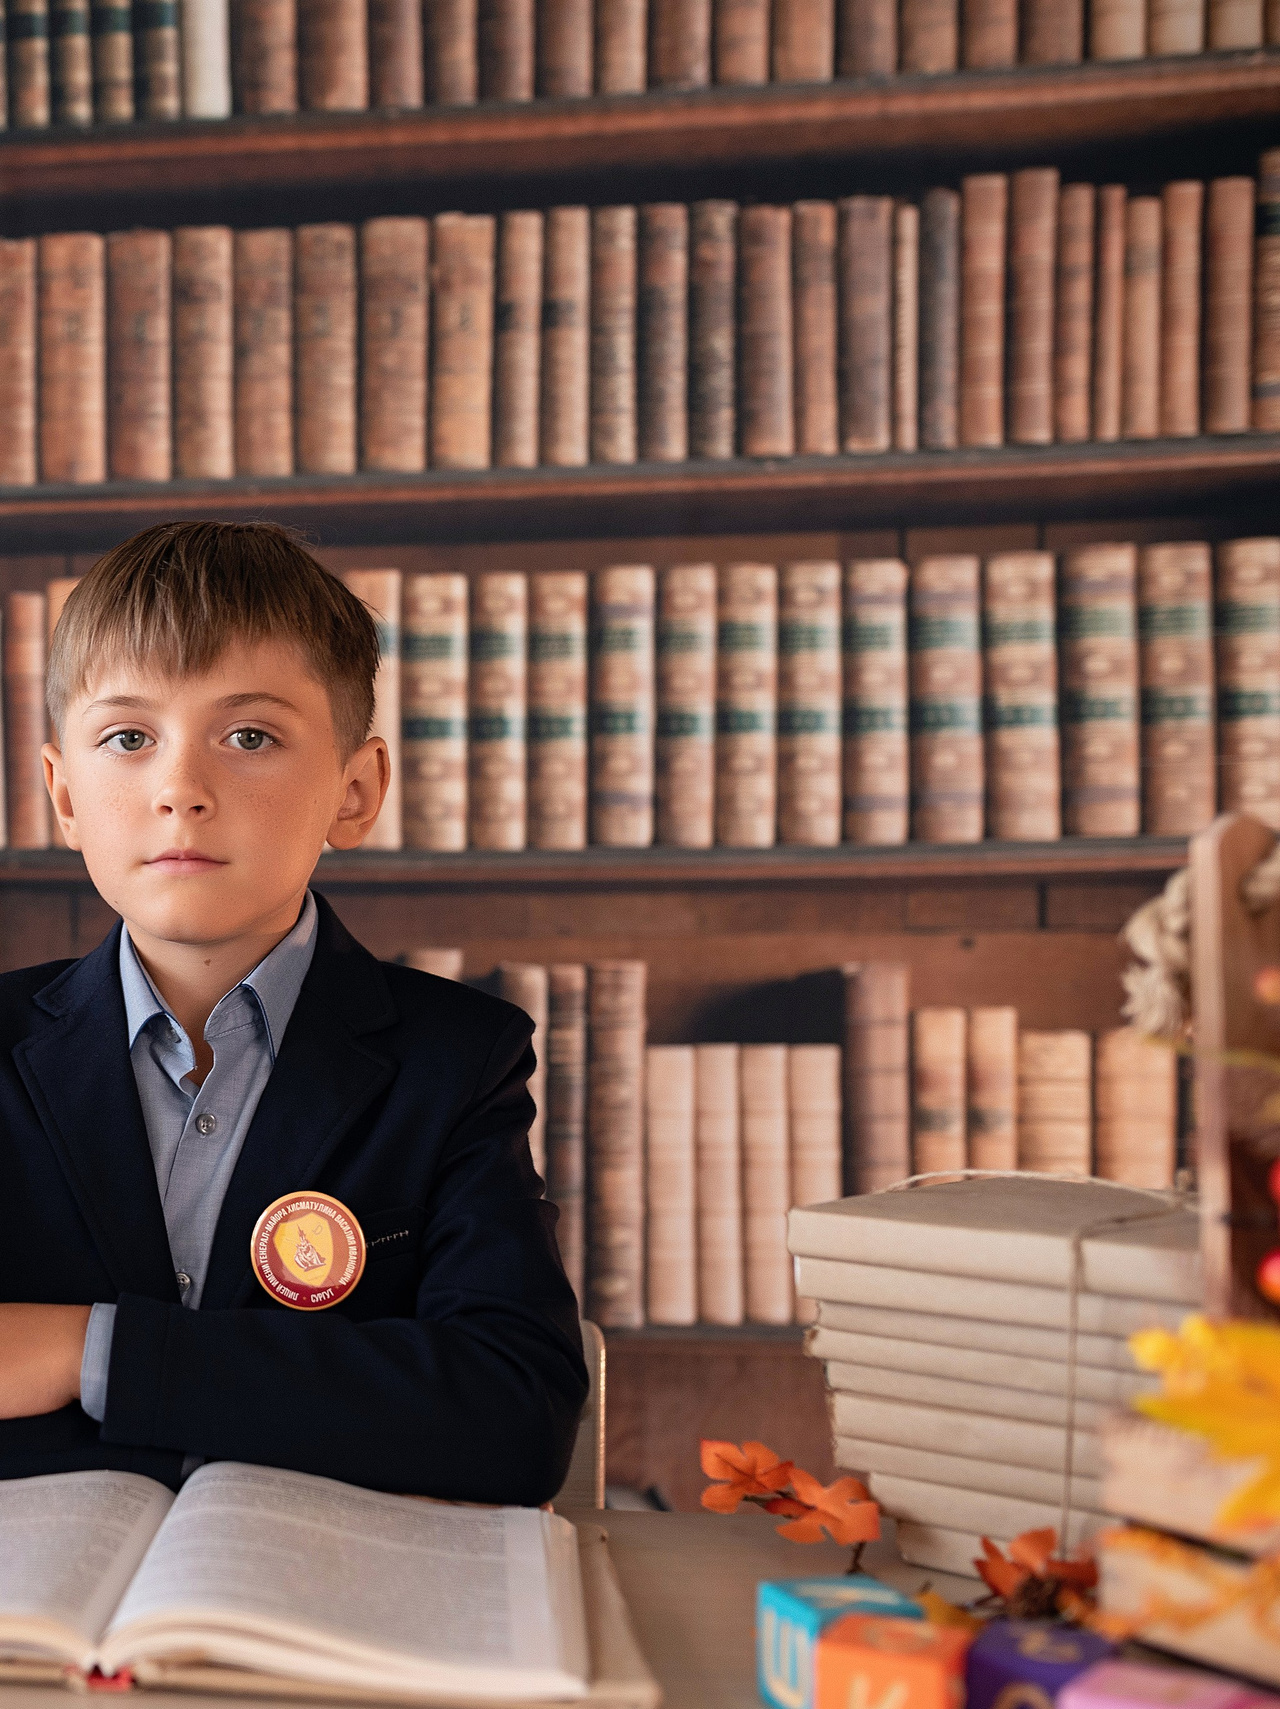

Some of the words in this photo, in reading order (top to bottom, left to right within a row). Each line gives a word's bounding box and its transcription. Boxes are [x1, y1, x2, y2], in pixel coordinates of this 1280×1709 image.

[286, 1201, 337, 1219] ХИСМАТУЛИНА
[334, 1213, 356, 1245] ВАСИЛИЯ
[261, 1264, 278, 1288] ИМЕНИ
[338, 1245, 358, 1286] ИВАНОВИЧА
[276, 1284, 300, 1301] ЛИЦЕЙ
[310, 1288, 335, 1303] СУРГУТ
